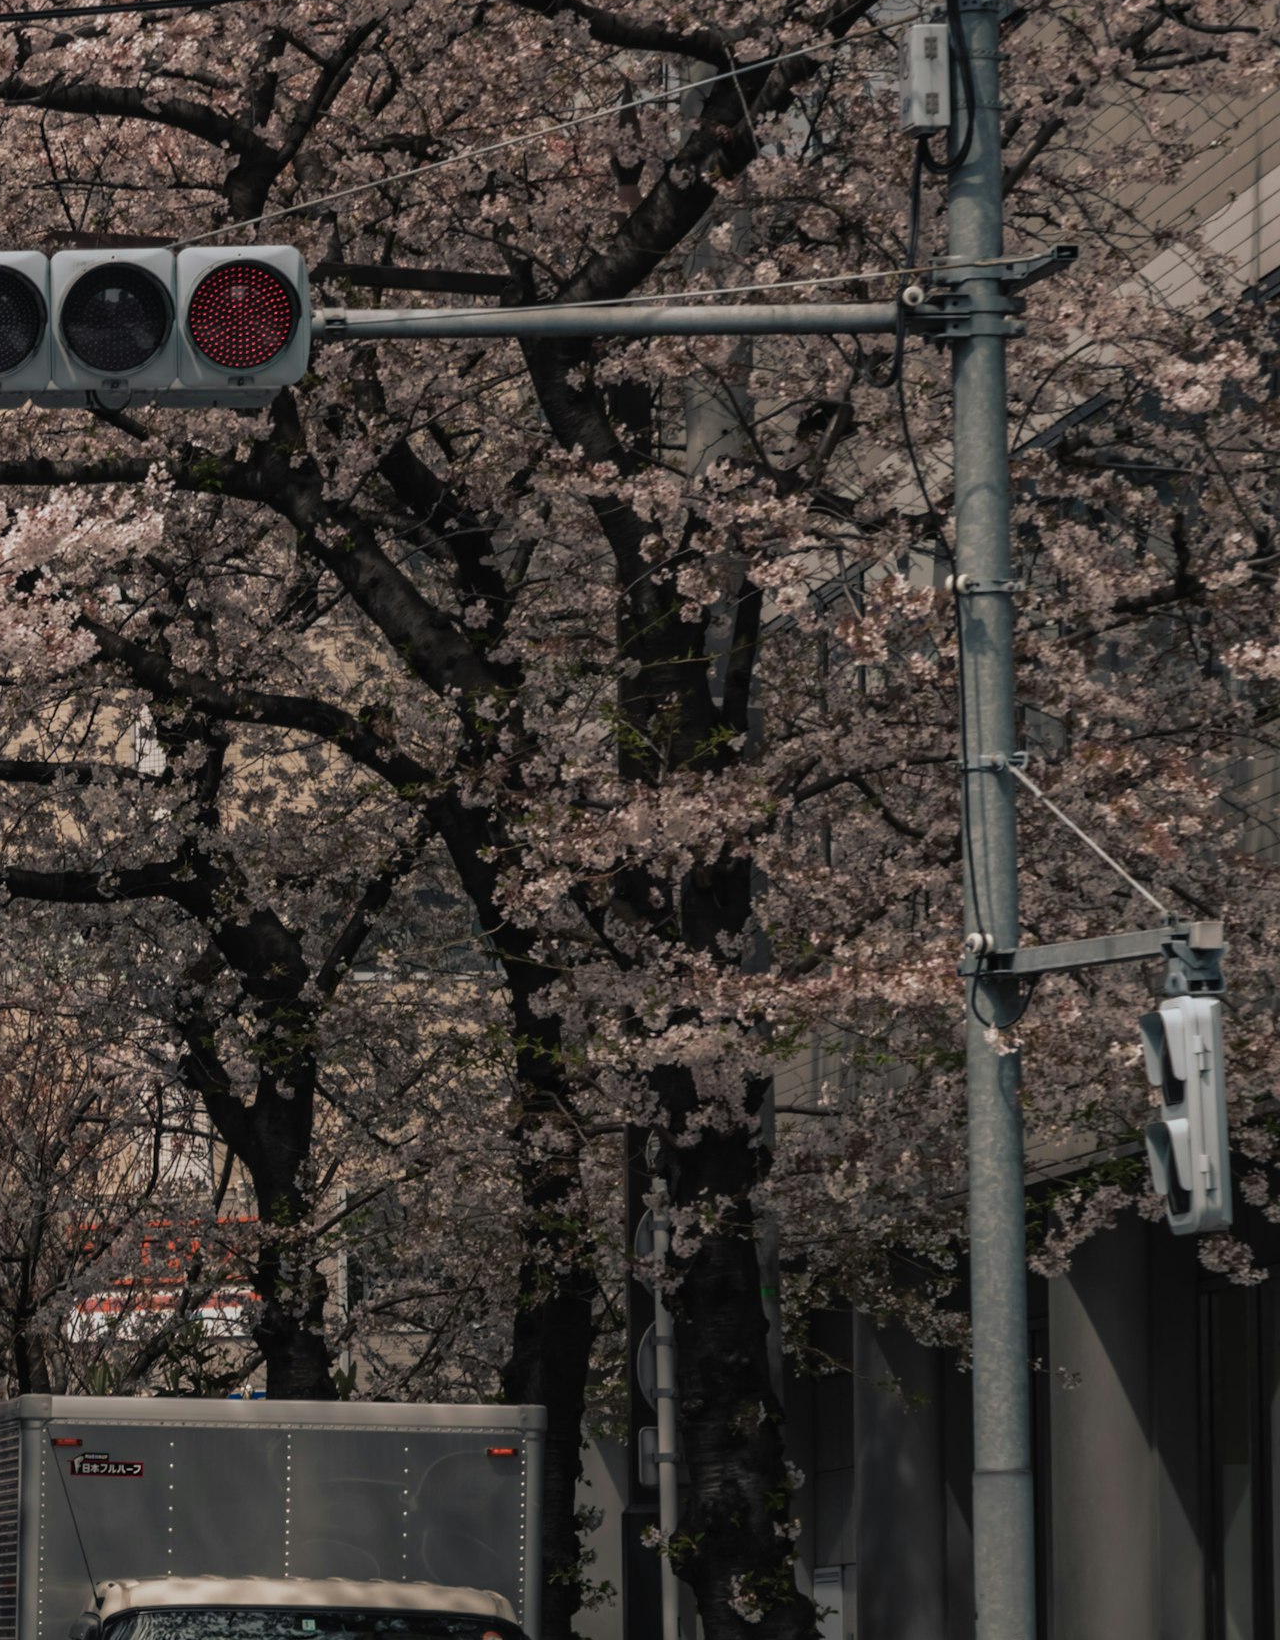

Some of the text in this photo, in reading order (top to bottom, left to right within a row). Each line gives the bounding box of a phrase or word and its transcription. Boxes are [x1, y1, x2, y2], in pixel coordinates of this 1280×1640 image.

[82, 1463, 142, 1475] 日本フルハーフ
